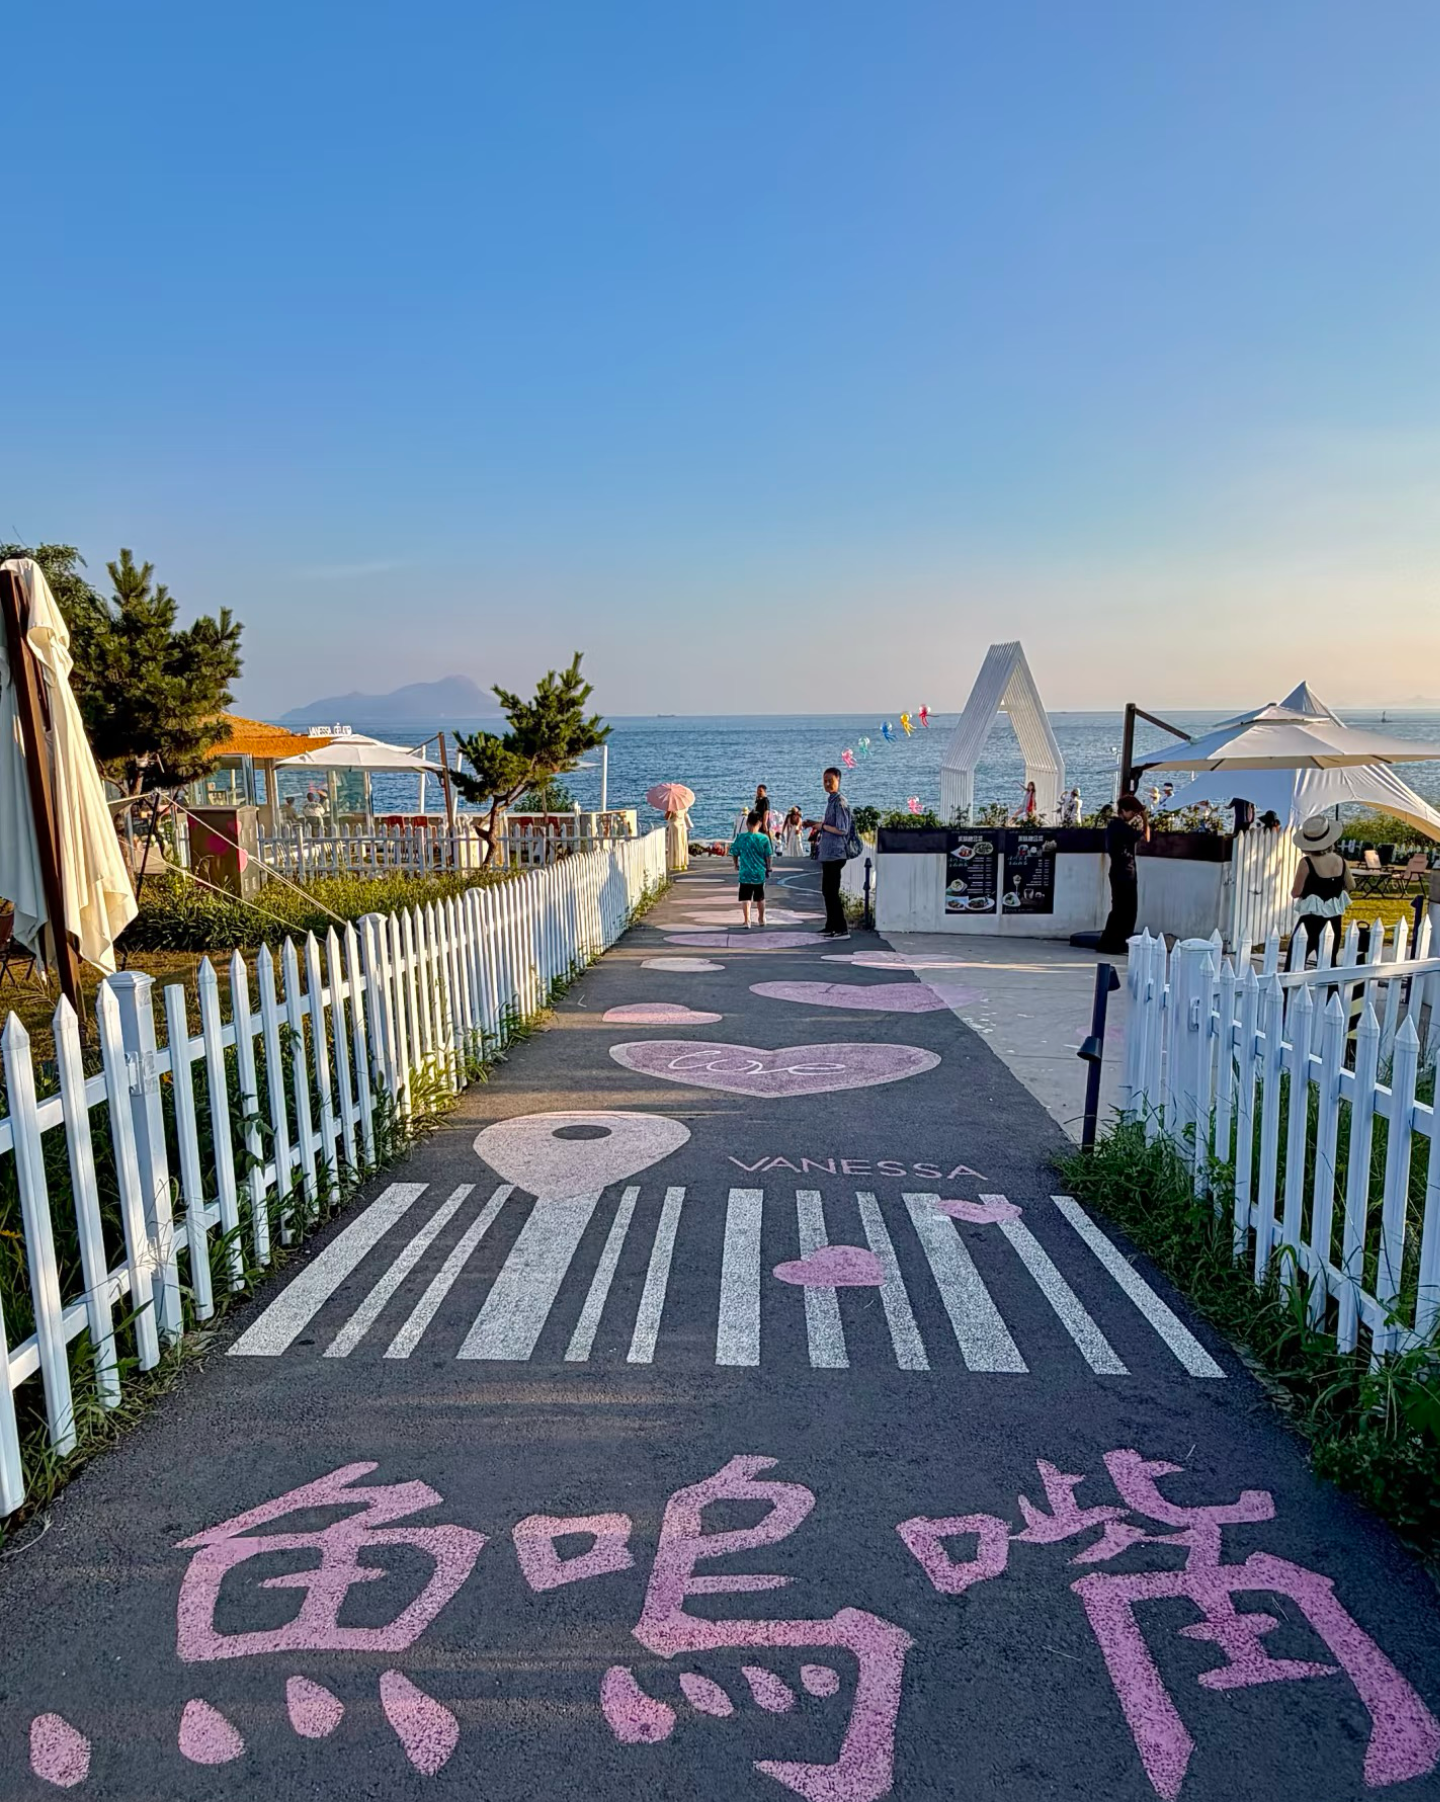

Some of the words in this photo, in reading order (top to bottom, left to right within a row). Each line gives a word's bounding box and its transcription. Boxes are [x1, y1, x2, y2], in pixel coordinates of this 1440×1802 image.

[667, 1050, 847, 1076] love
[728, 1156, 988, 1181] VANESSA
[30, 1448, 1440, 1802] 魚鳴嘴
